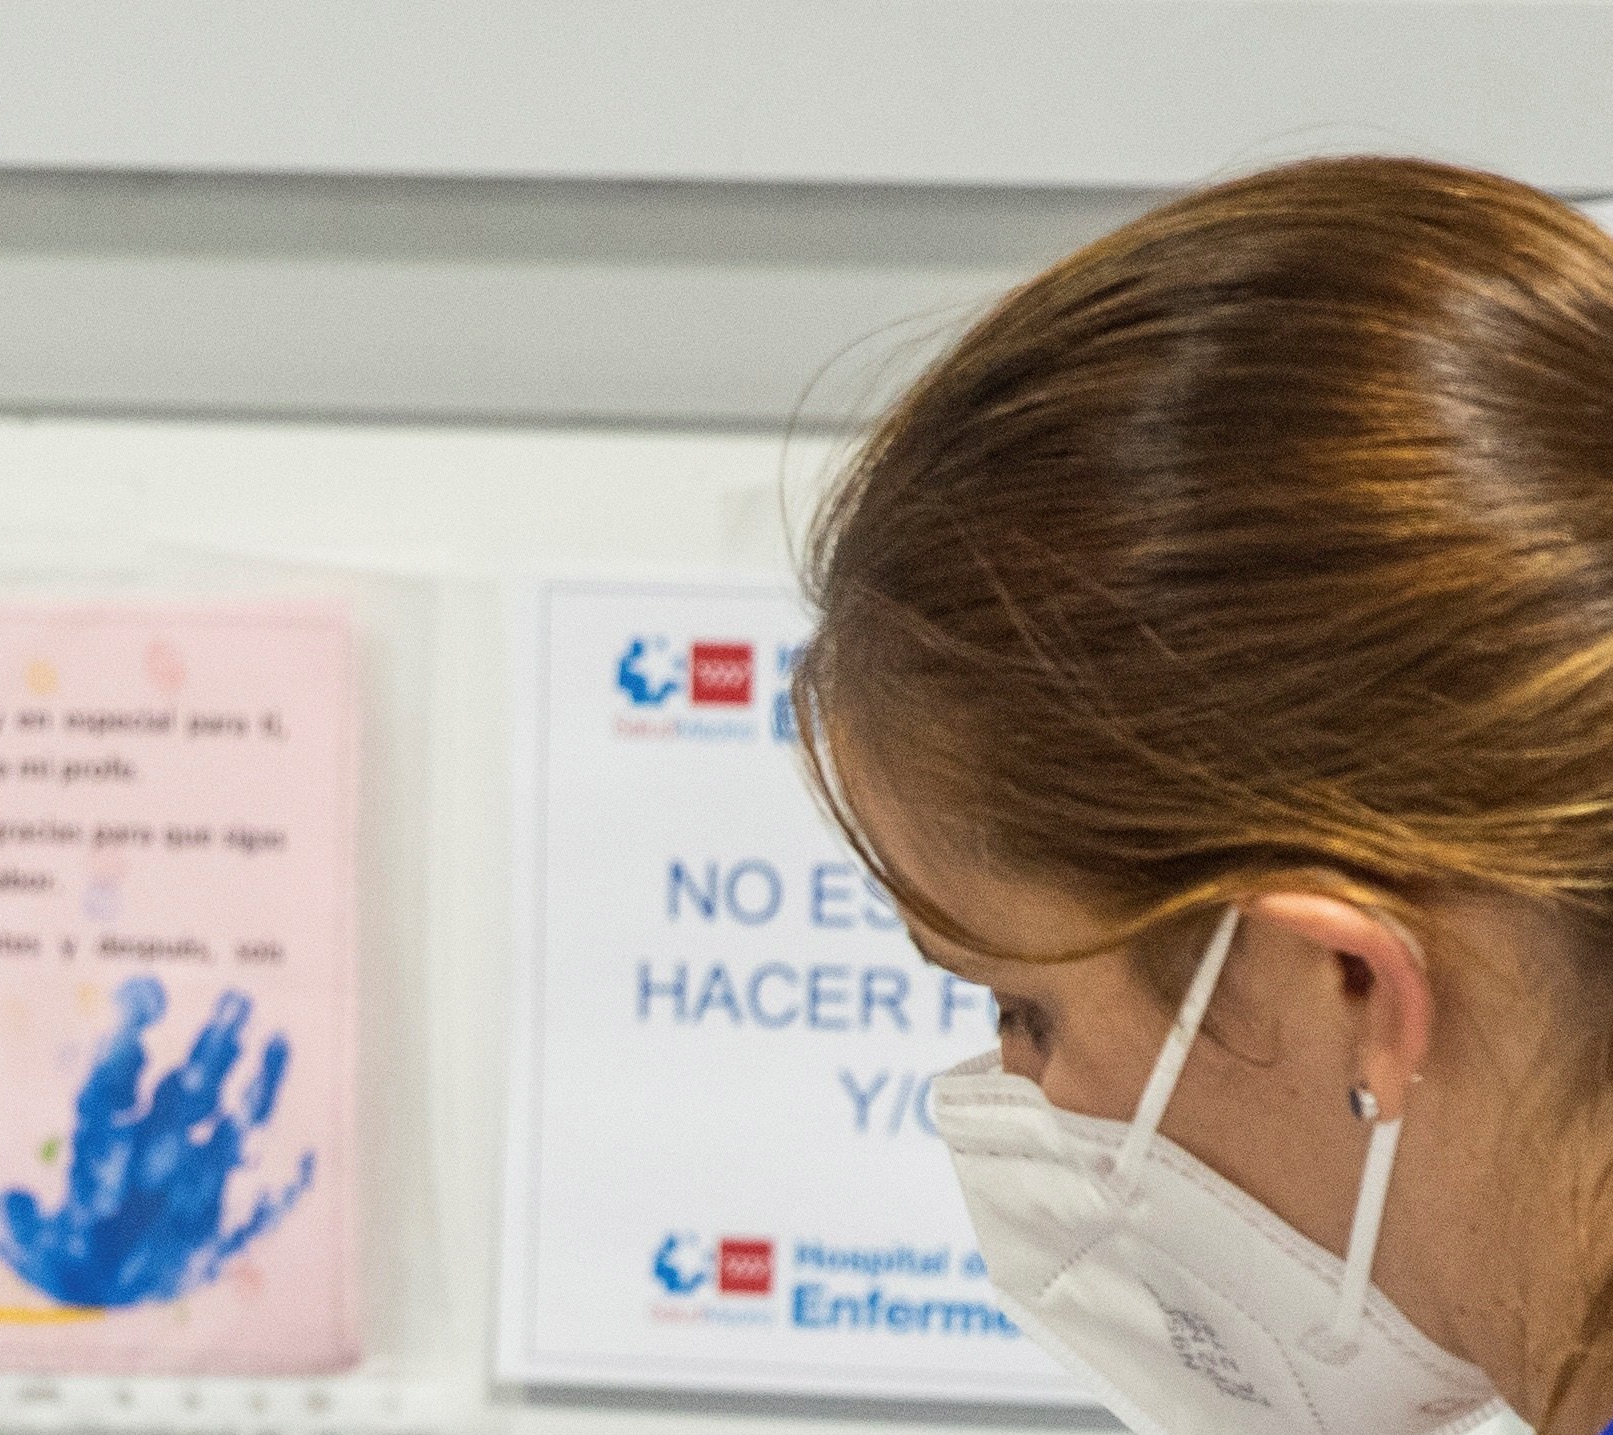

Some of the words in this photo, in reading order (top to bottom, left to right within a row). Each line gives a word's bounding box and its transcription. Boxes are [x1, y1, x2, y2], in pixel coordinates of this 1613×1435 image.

[64, 709, 175, 735] especial
[665, 858, 784, 926] NO
[635, 960, 912, 1034] HACER
[794, 1240, 950, 1276] Hospital
